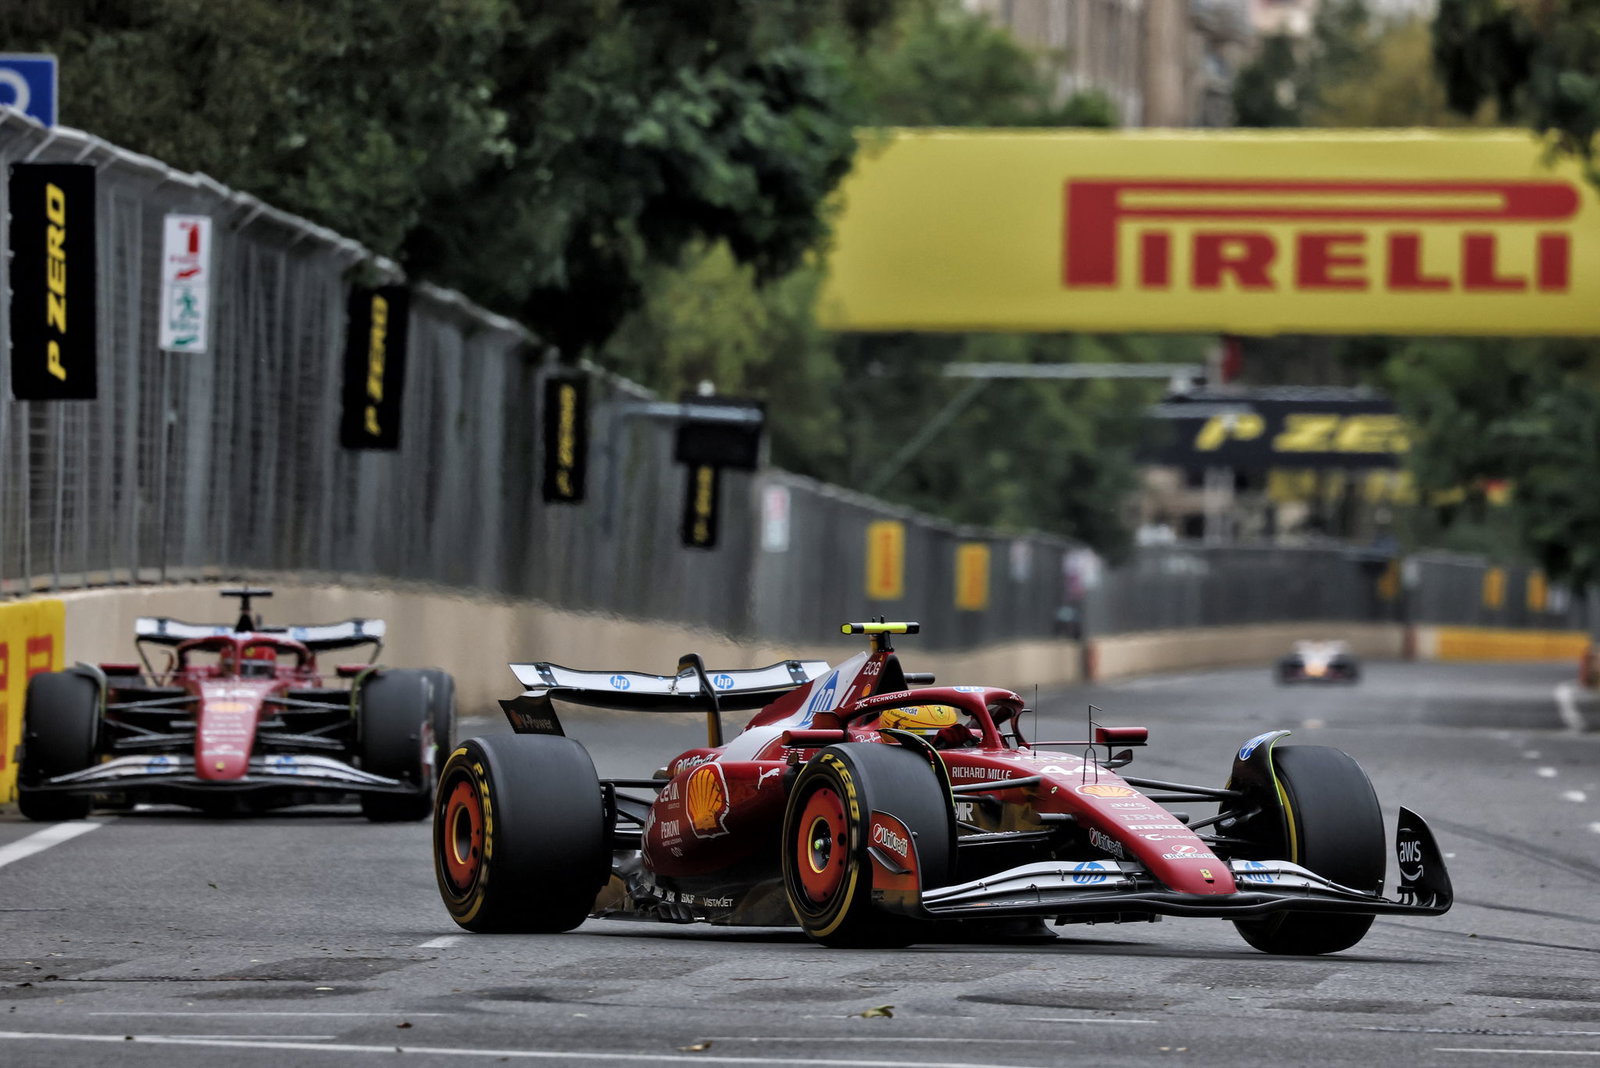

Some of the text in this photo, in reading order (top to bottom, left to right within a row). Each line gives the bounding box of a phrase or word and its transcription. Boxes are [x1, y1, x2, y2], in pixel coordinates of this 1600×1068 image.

[1064, 179, 1580, 290] PIRELLI
[46, 183, 66, 381] P ZERO
[1195, 412, 1264, 450] P
[863, 661, 881, 675] ZCG
[613, 675, 629, 690] hp
[717, 674, 732, 689] hp
[869, 691, 912, 704] TECHNOLOGY
[952, 767, 1012, 780] RICHARD MILLE
[1039, 765, 1107, 776] 44
[820, 754, 860, 821] P ZERO
[473, 761, 493, 861] P ZERO
[881, 827, 908, 858] UniCredit
[1400, 840, 1422, 862] aws
[1075, 861, 1105, 885] hp
